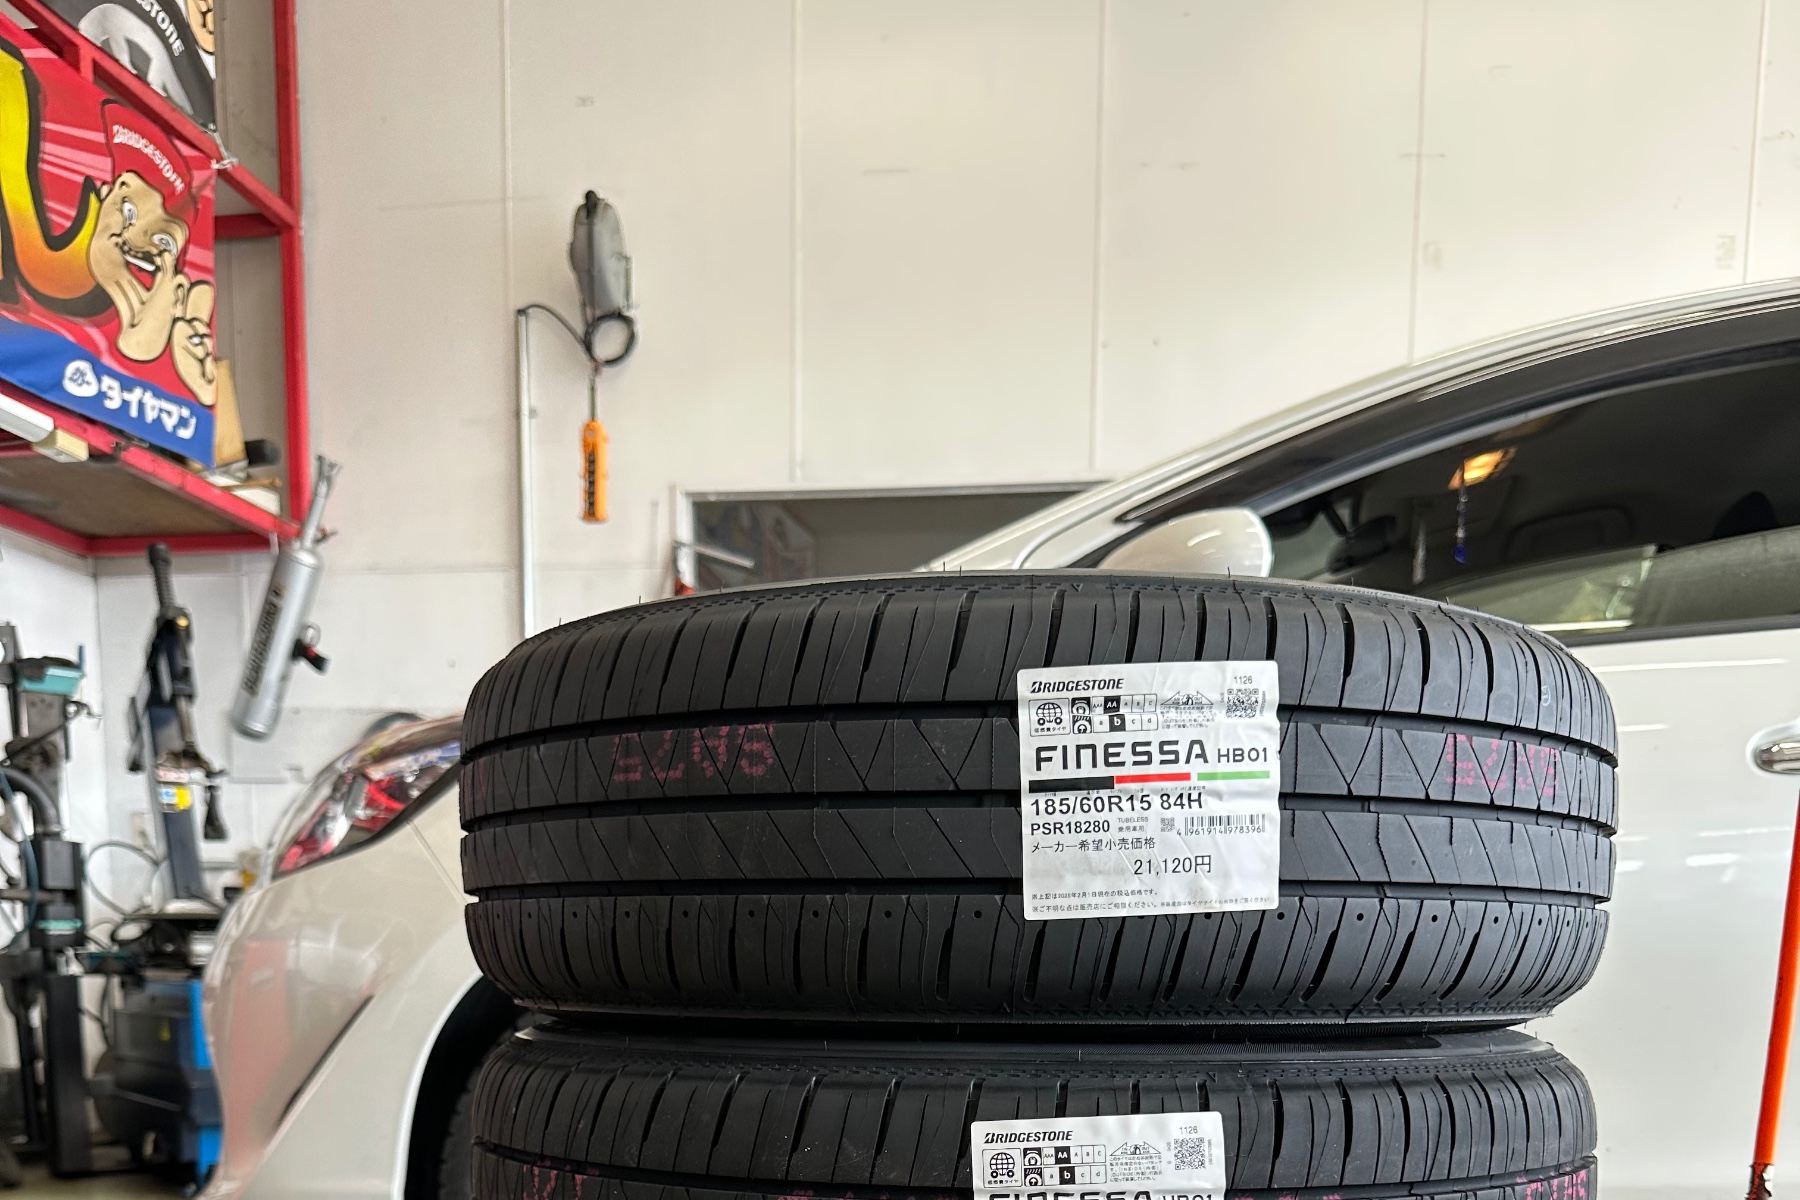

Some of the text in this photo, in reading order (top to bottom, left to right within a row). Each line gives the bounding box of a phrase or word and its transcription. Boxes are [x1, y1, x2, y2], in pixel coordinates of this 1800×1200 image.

[101, 375, 196, 439] タイヤマン
[1030, 679, 1124, 693] BRIDGESTONE
[1233, 675, 1253, 685] 1126
[1114, 717, 1121, 726] b
[1036, 739, 1268, 771] FINESSA HB01
[1031, 794, 1152, 816] 185/60R15
[1160, 792, 1203, 810] 84H
[1031, 820, 1110, 836] PSR18280
[1031, 837, 1156, 853] メーカー希望小売価格
[1133, 855, 1212, 877] 21,120円
[983, 1130, 1073, 1144] BRIDGESTONE
[1179, 1125, 1198, 1134] 1126
[1064, 1170, 1070, 1179] b
